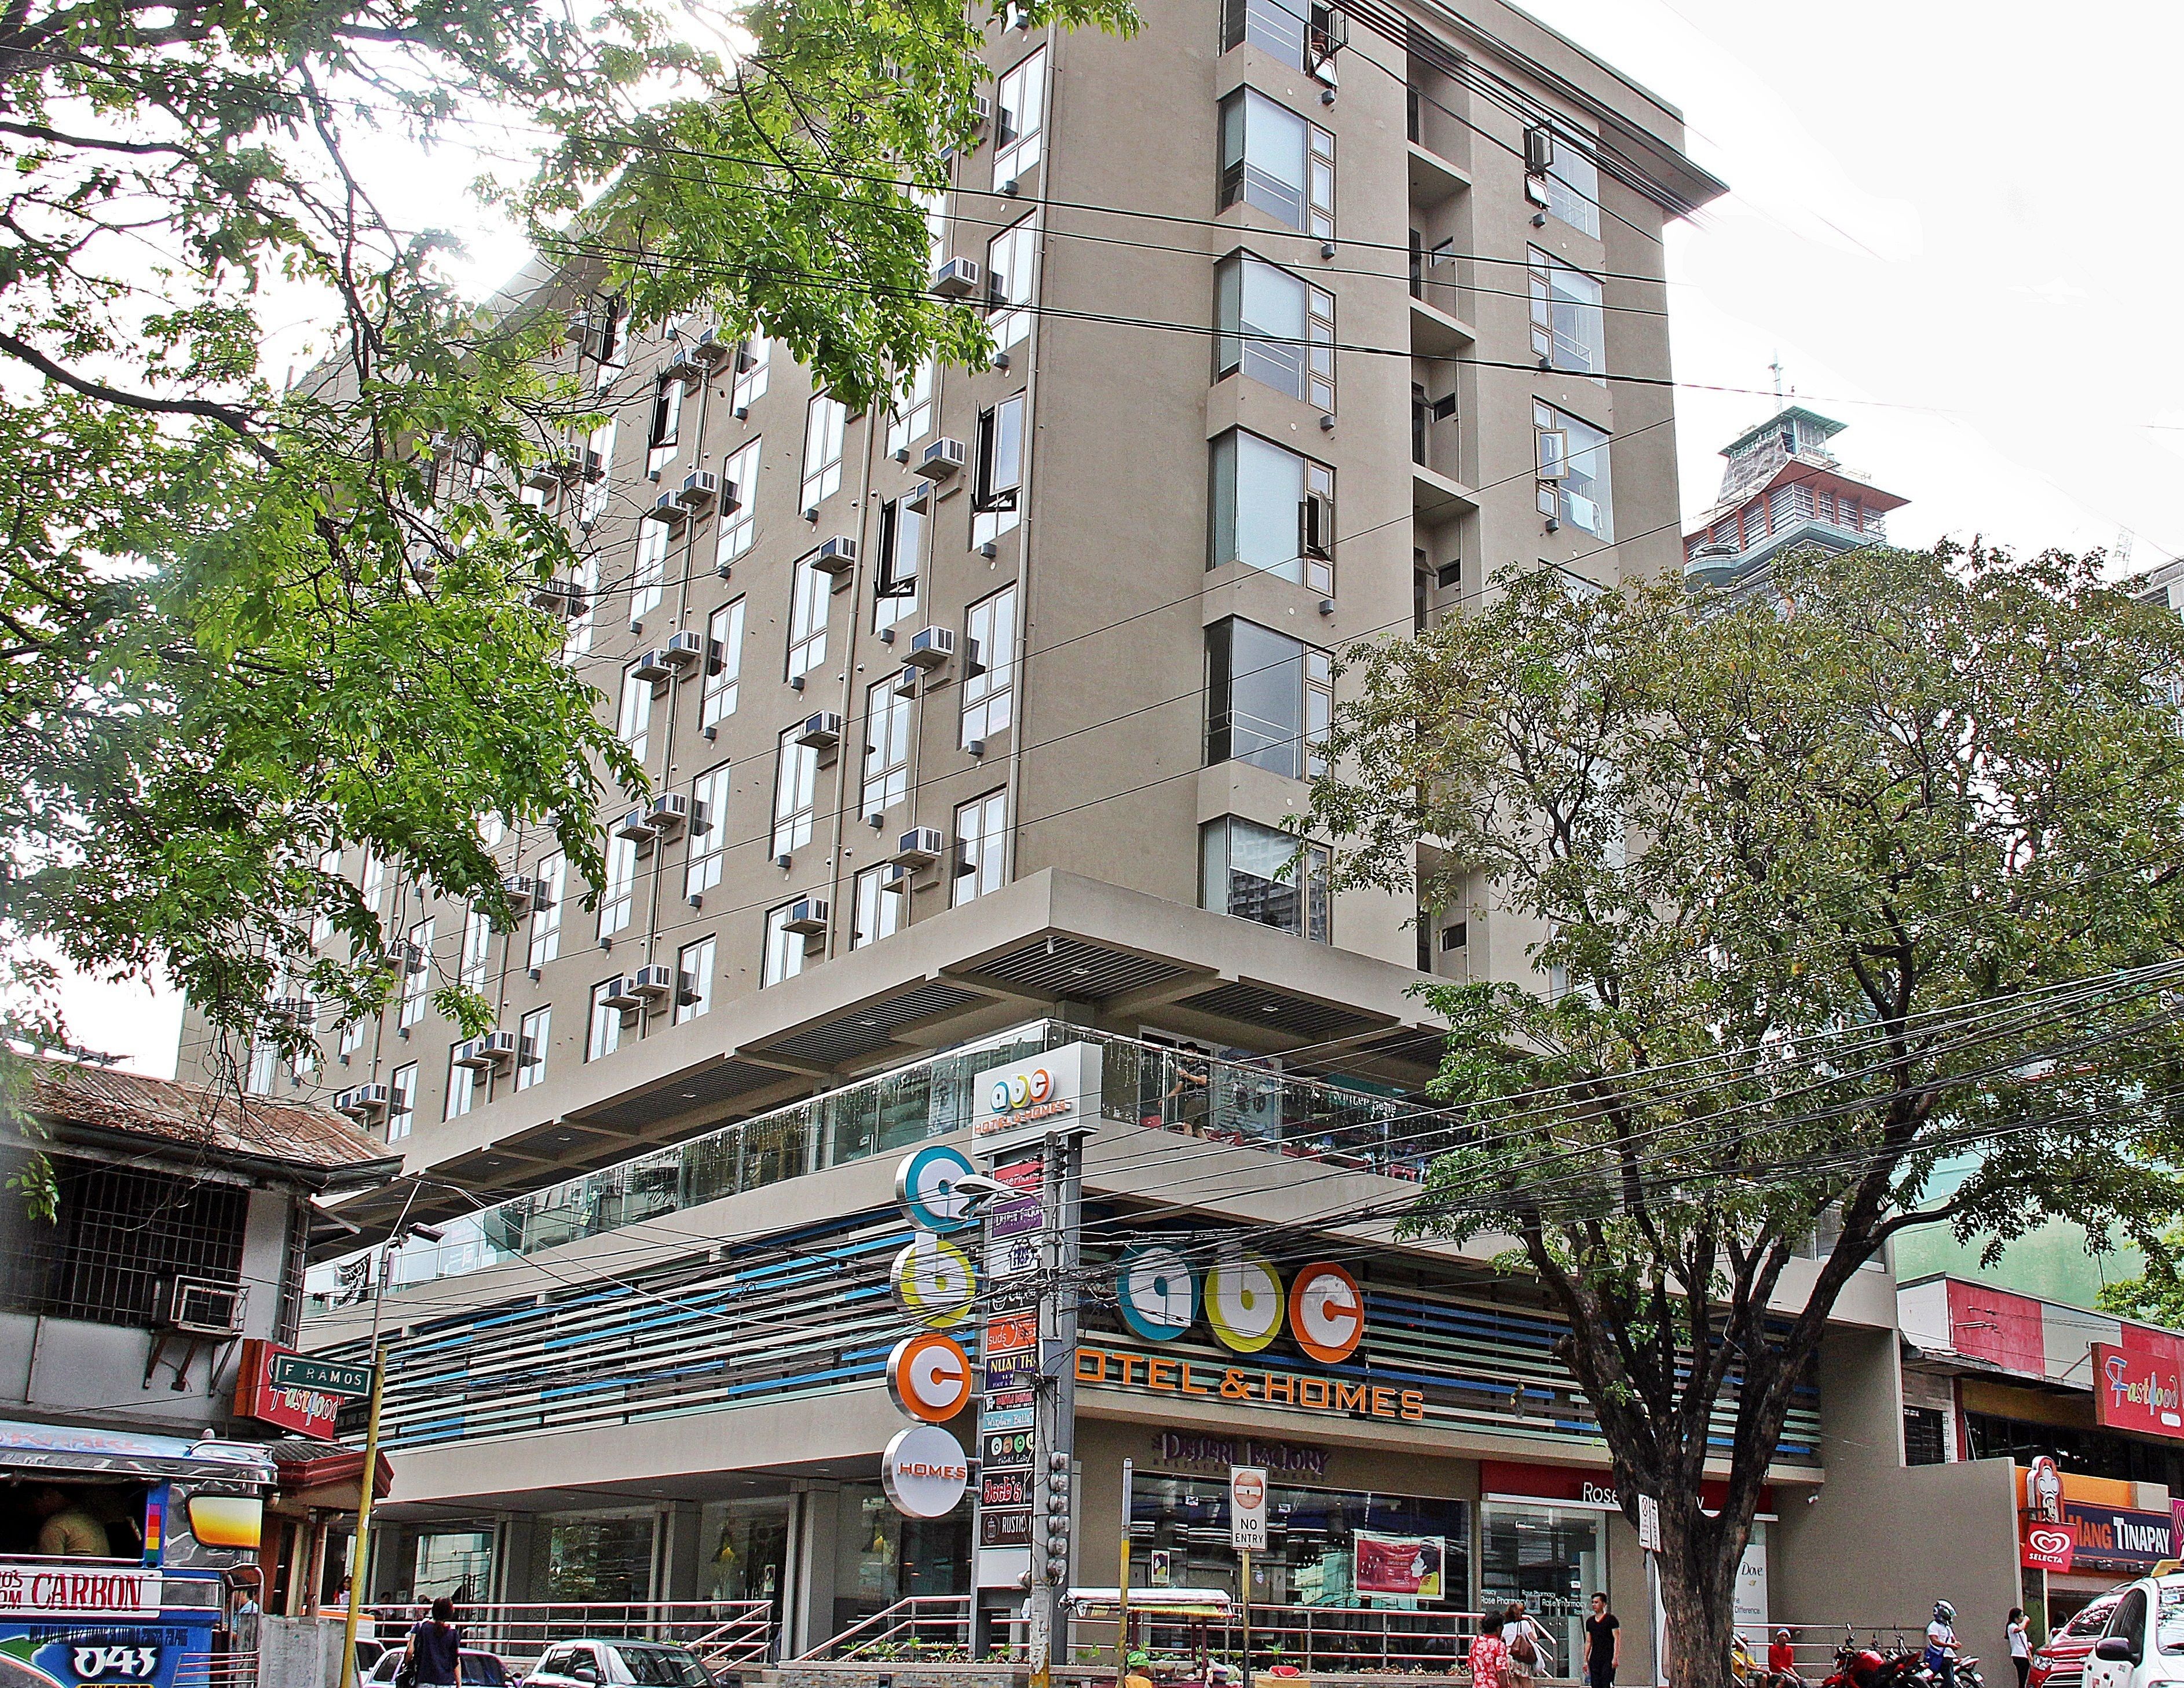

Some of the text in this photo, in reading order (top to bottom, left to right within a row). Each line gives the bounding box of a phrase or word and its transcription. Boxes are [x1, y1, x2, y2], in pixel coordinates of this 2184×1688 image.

[990, 1069, 1051, 1113] abc
[975, 1116, 1013, 1135] HOTEL
[1025, 1099, 1071, 1120] HOMES
[1121, 1243, 1362, 1357] abc
[988, 1333, 1007, 1345] suds
[285, 1364, 362, 1386] F RAMOS
[990, 1357, 1018, 1373] NUAT
[1075, 1349, 1424, 1421] OTEL & HOMES
[2105, 1355, 2179, 1416] Fastfood
[899, 1462, 967, 1478] HOMES
[984, 1475, 1022, 1503] Jeeb's
[1583, 1482, 1619, 1504] Rose
[1002, 1515, 1026, 1533] RUSTIC
[1241, 1518, 1257, 1530] NO
[2068, 1514, 2170, 1555] MANG TINAPAY
[1235, 1533, 1264, 1543] ENTRY
[1742, 1561, 1763, 1576] Dove
[2029, 1552, 2063, 1564] SELECTA
[0, 1569, 23, 1588] O'S
[31, 1573, 143, 1612] CARBON
[1481, 1596, 1495, 1604] Rose
[74, 1646, 158, 1678] 043
